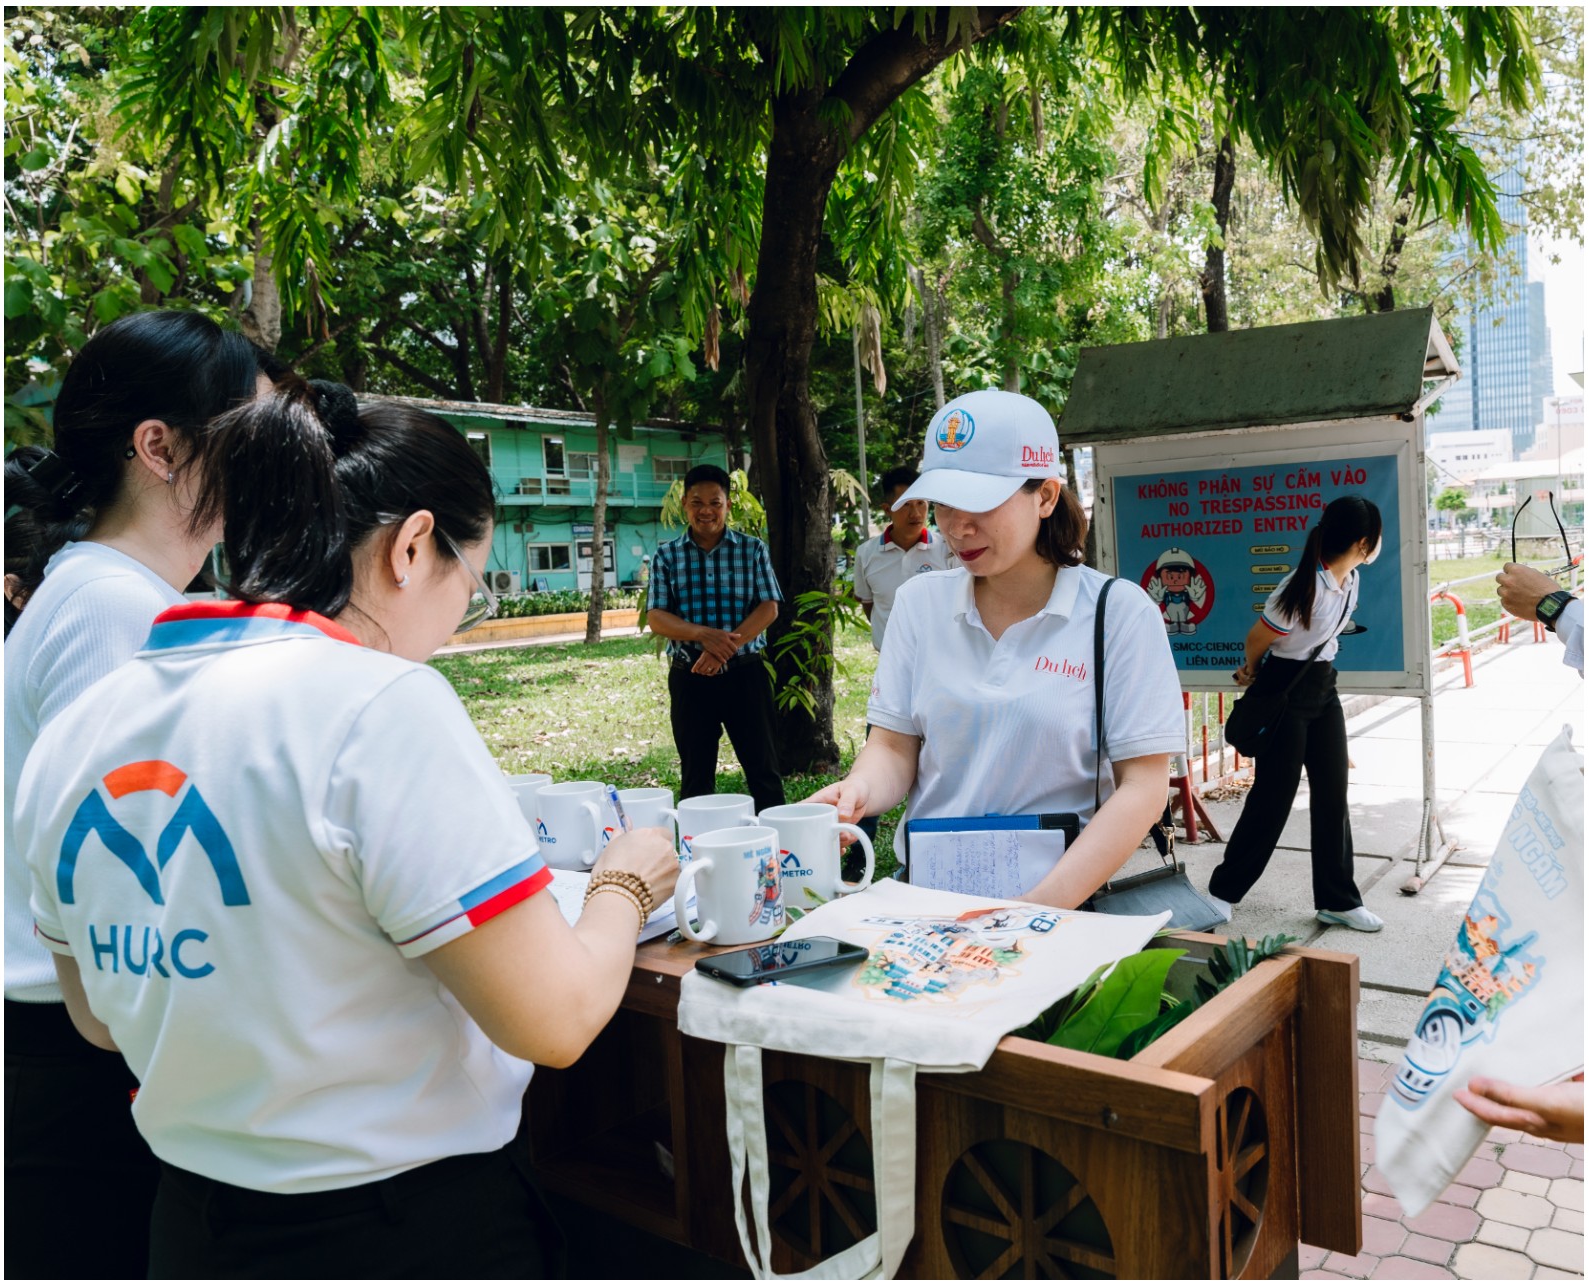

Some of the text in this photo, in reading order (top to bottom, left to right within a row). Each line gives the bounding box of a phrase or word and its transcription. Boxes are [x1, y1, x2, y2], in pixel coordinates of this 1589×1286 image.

[1021, 445, 1039, 462] Du
[1138, 464, 1367, 499] KHÔNG PHẬN SỰ CẤM VÀO
[1169, 502, 1190, 517] NO
[1141, 515, 1309, 538] AUTHORIZED ENTRY
[1034, 655, 1059, 673] Du
[1186, 655, 1209, 666] LIÊN
[1212, 656, 1241, 666] DANH
[781, 868, 814, 878] METRO
[89, 925, 216, 979] HURC
